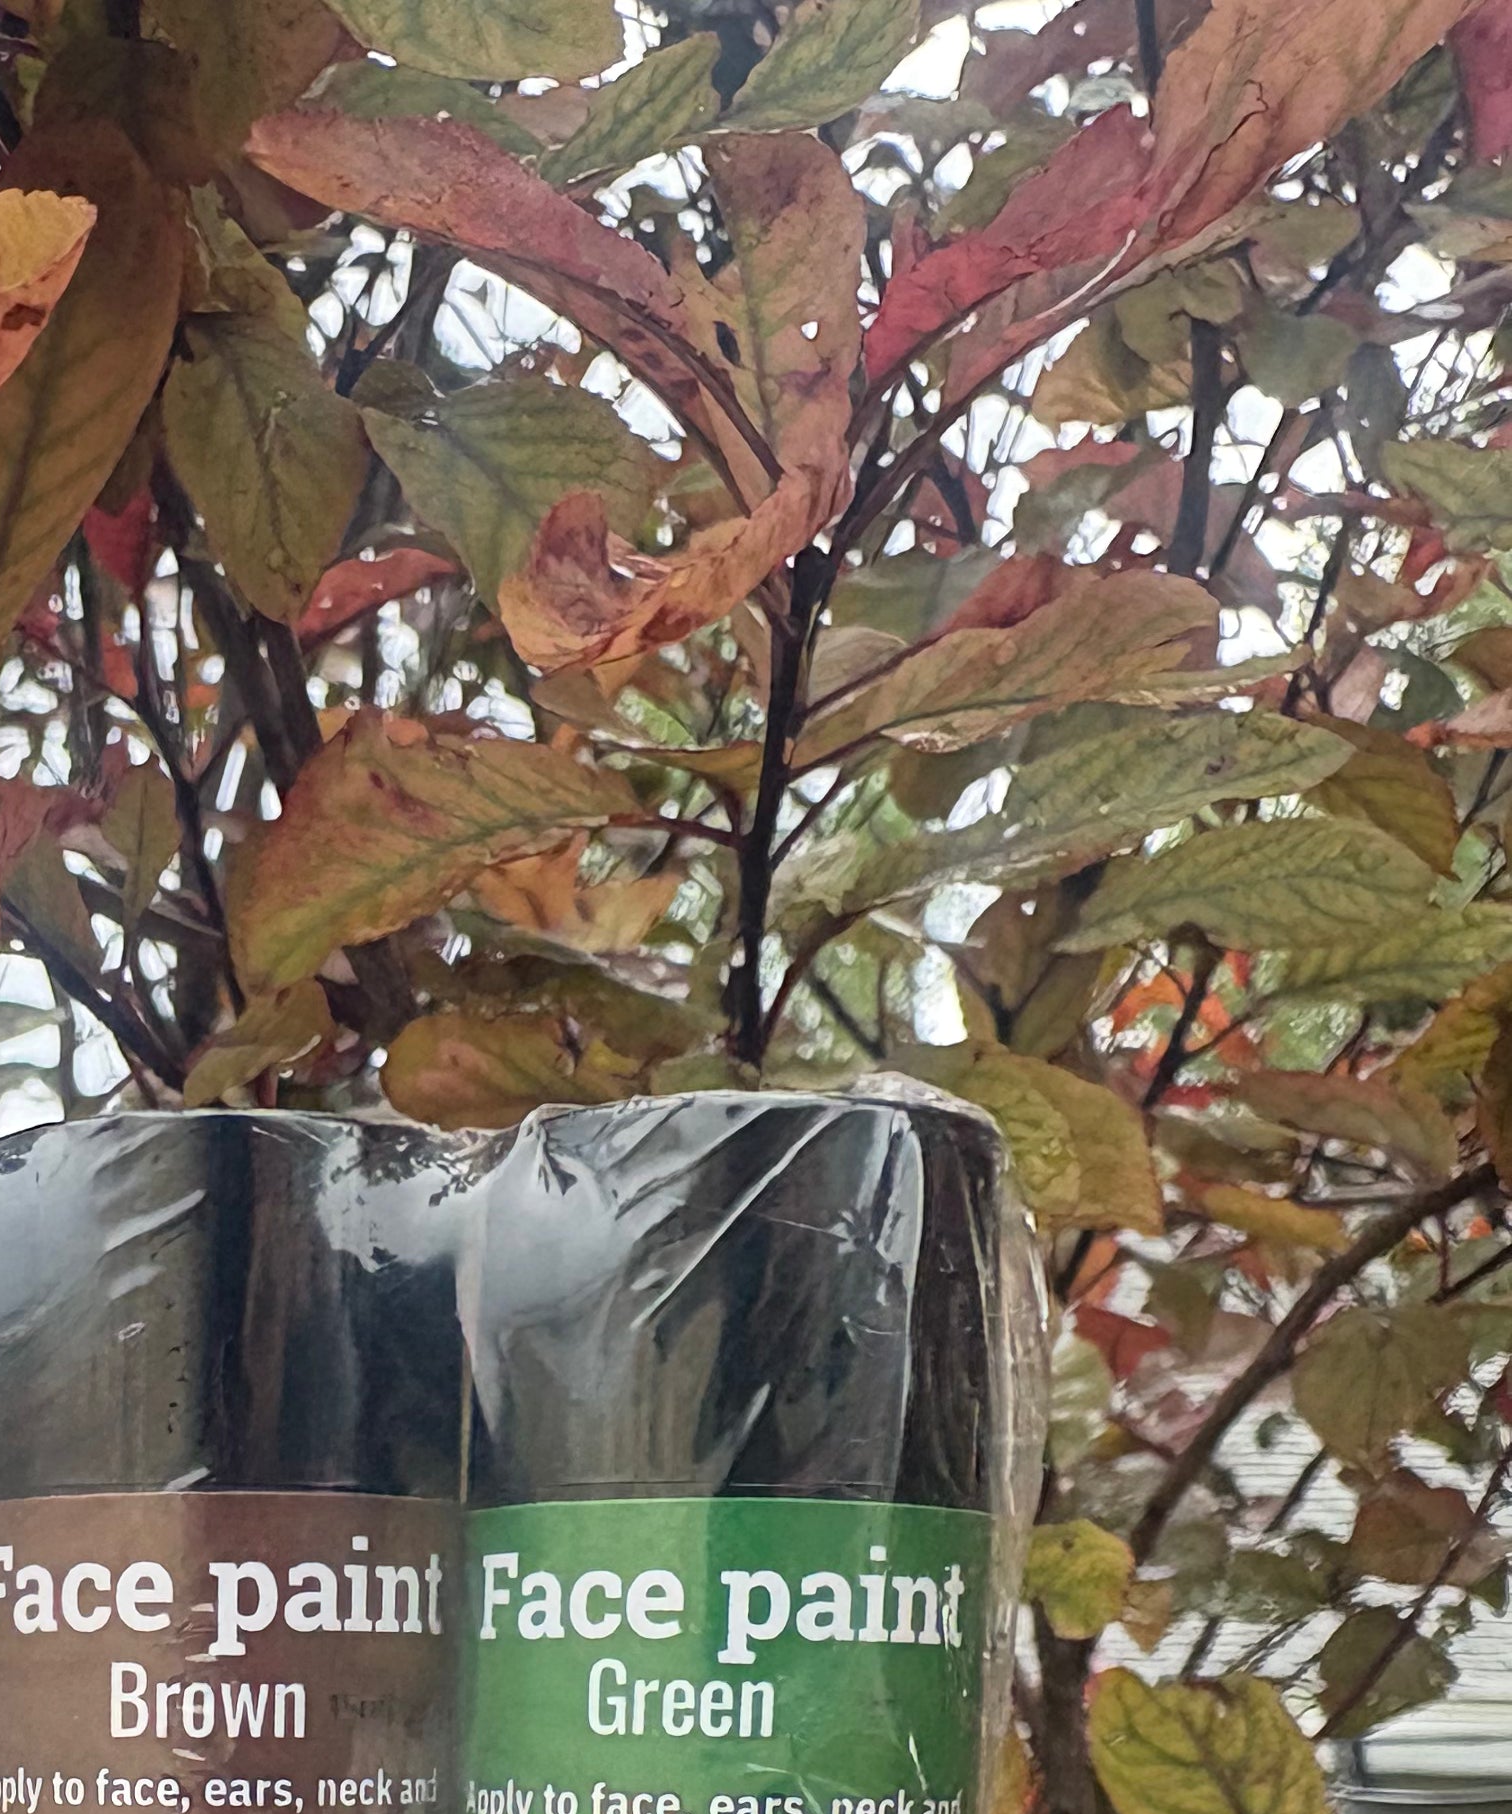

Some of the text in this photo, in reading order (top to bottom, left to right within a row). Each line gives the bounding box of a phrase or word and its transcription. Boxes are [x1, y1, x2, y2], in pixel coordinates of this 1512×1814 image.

[208, 1536, 443, 1656] paint
[480, 1545, 965, 1665] Face paint
[110, 1661, 306, 1739] Brown
[588, 1657, 774, 1738] Green
[52, 1770, 85, 1806] to
[95, 1767, 191, 1814] face,
[204, 1775, 304, 1814] ears,
[317, 1768, 392, 1807] neck
[400, 1767, 437, 1804] and
